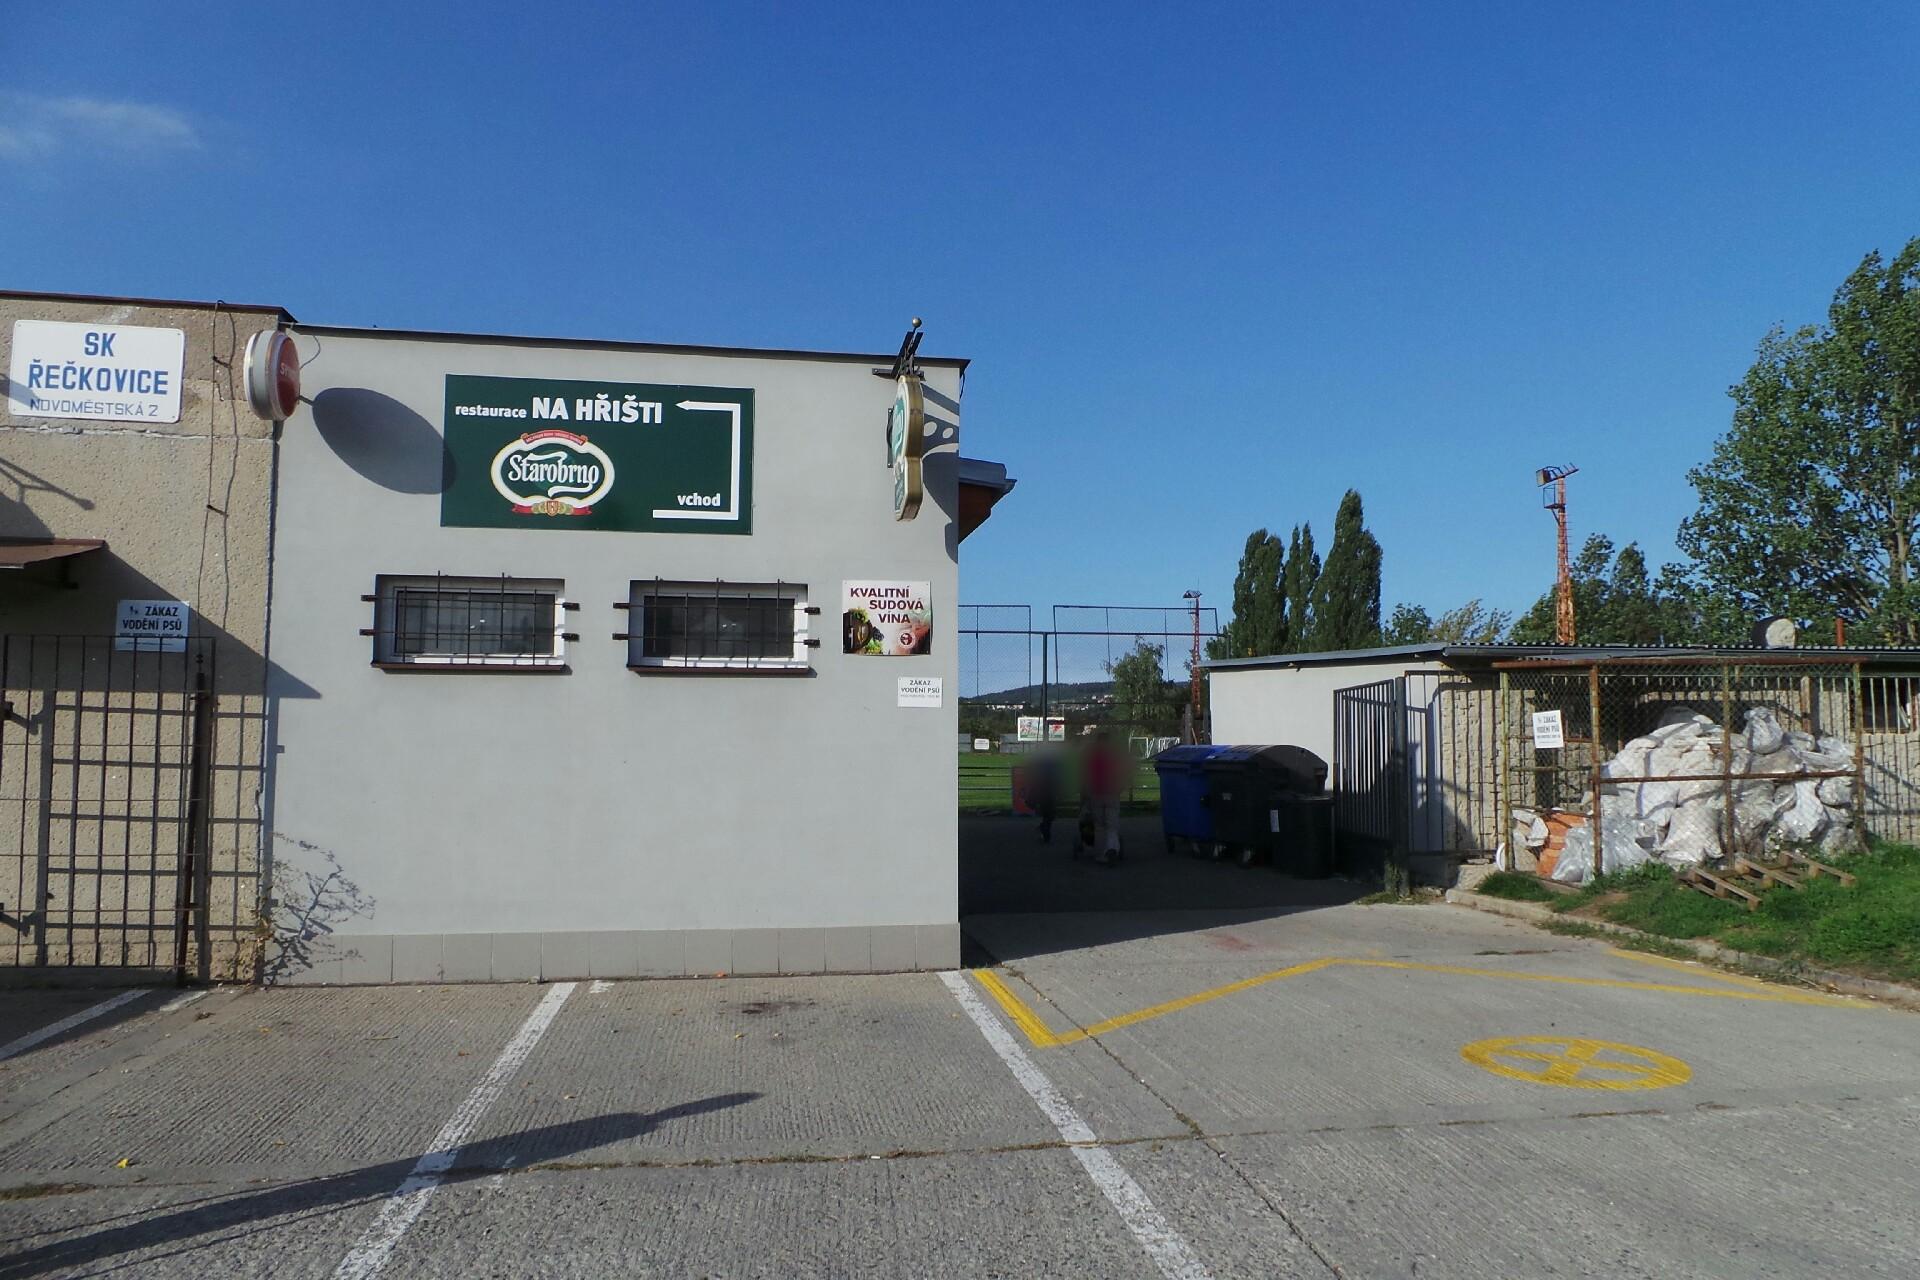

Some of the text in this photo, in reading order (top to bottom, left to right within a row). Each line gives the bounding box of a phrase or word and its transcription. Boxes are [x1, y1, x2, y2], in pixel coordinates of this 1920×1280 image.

[84, 332, 117, 356] SK
[28, 359, 168, 395] ŘEČKOVICE
[29, 398, 158, 417] NOVOMĚSTSKÁ 2
[455, 393, 662, 424] restaurace NA HŘIŠTI
[508, 451, 599, 497] Starobrno
[677, 493, 721, 507] vchod
[850, 585, 910, 598] KVALITNÍ
[145, 605, 178, 616] ZÁKAZ
[869, 597, 924, 610] SUDOVÁ
[122, 618, 182, 630] VODĚNÍ PSŮ
[878, 611, 910, 623] VÍNA
